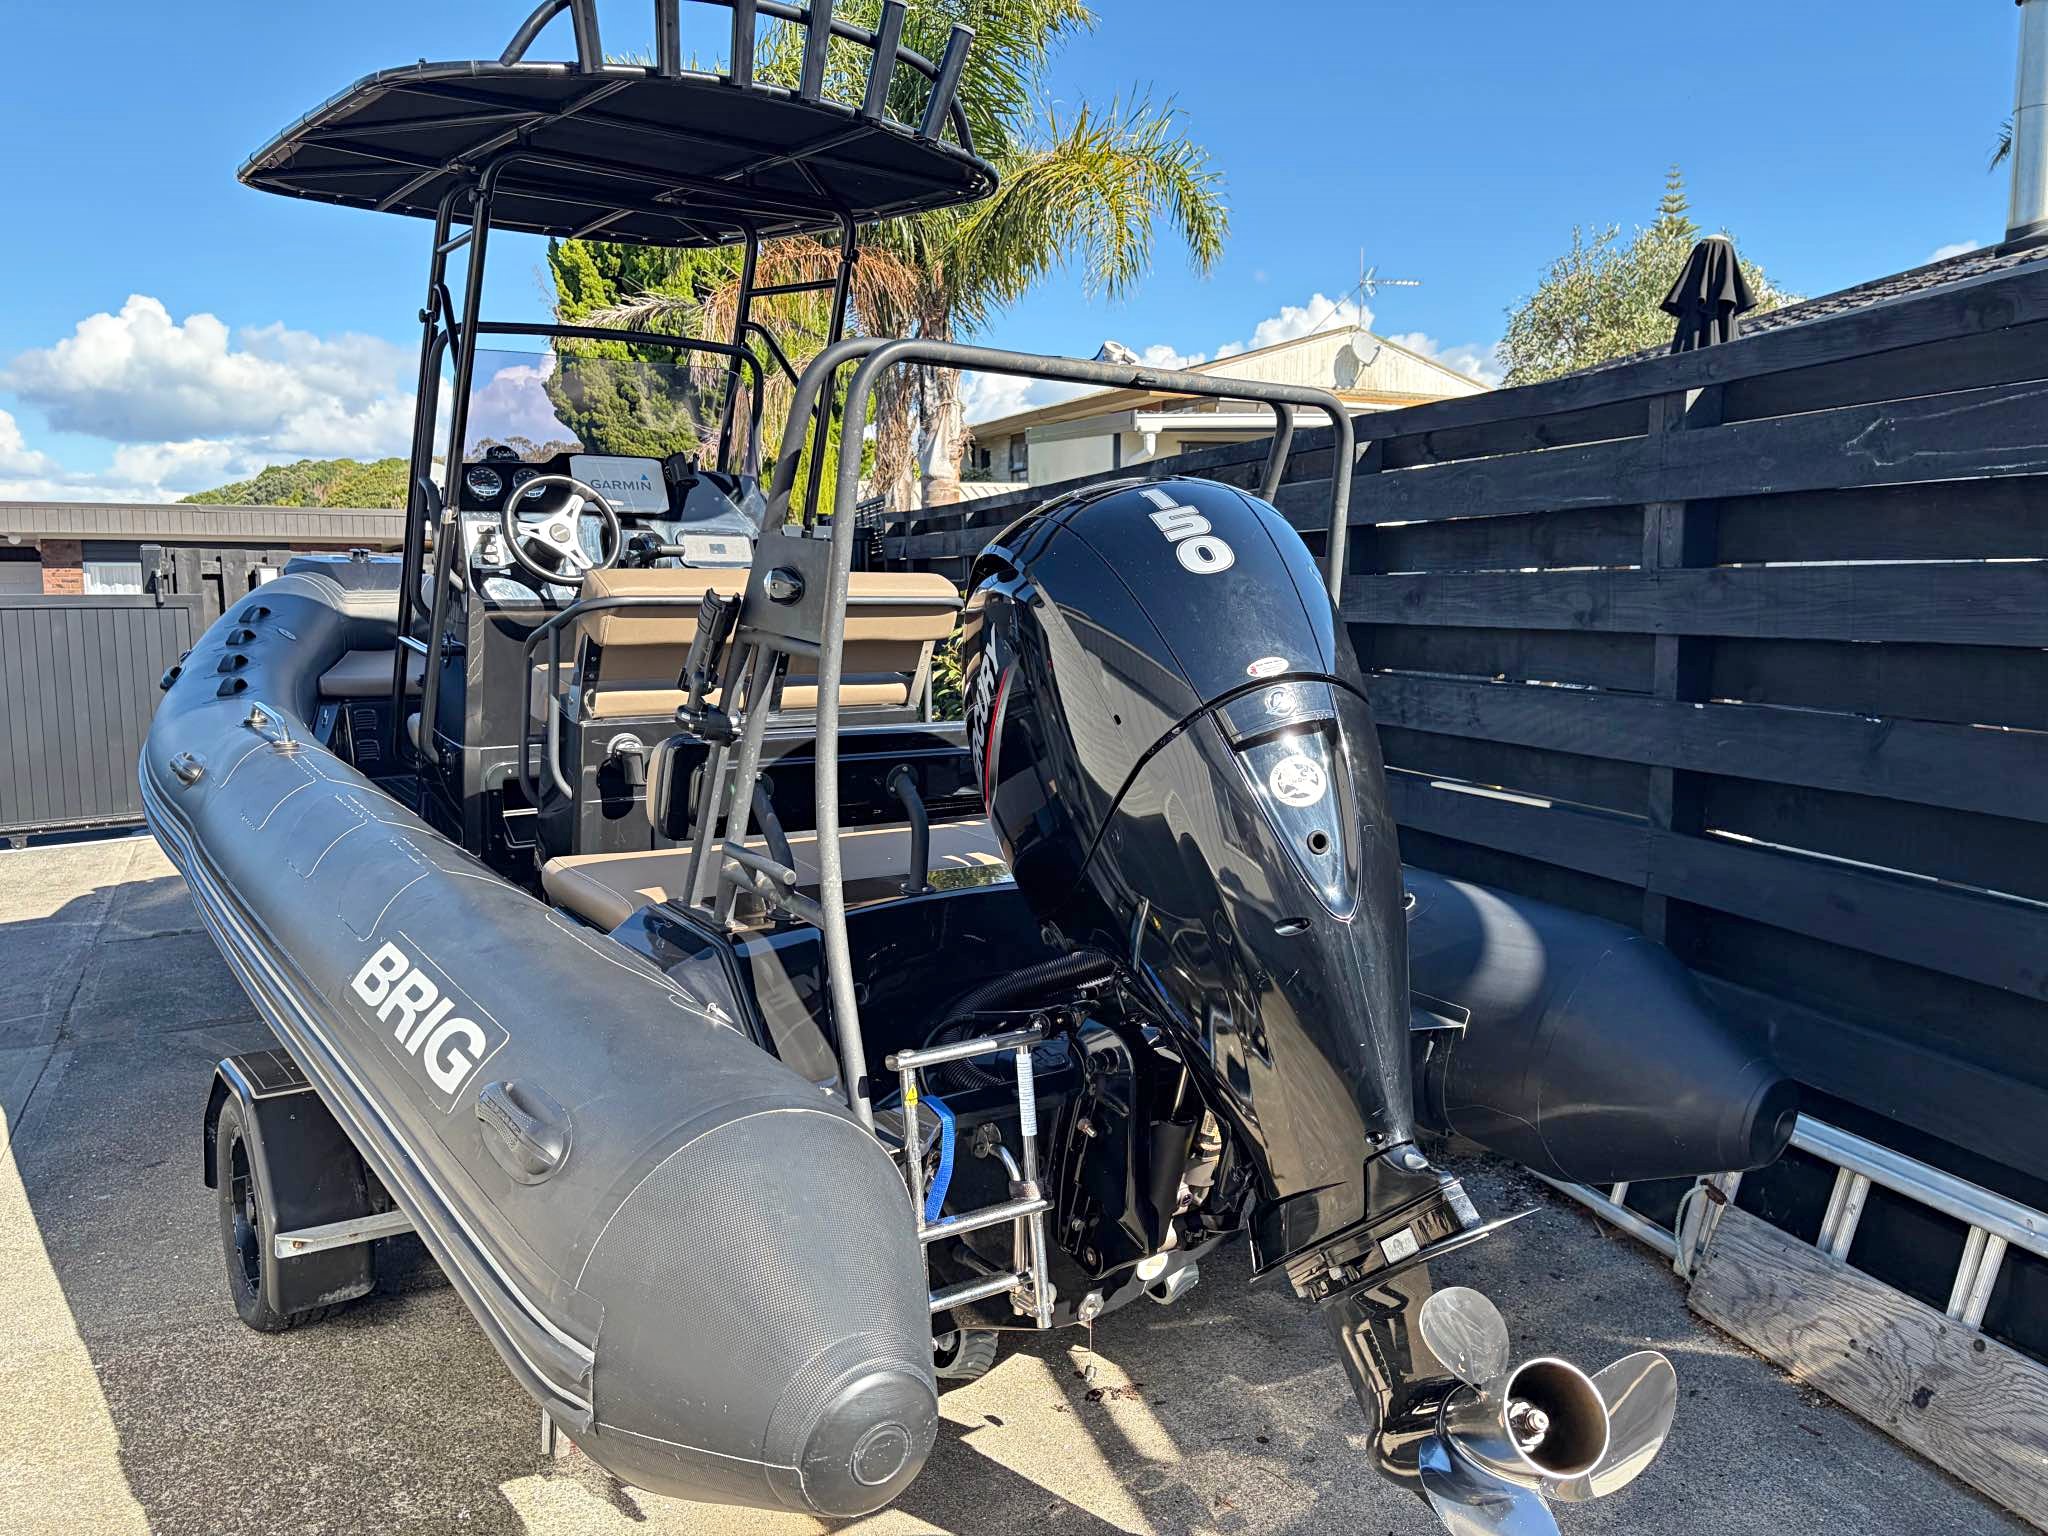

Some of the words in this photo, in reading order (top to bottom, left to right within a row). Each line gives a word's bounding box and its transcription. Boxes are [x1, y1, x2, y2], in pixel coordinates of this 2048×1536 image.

[590, 480, 652, 491] GARMIN
[1138, 488, 1235, 574] 150
[351, 941, 486, 1095] BRIG
